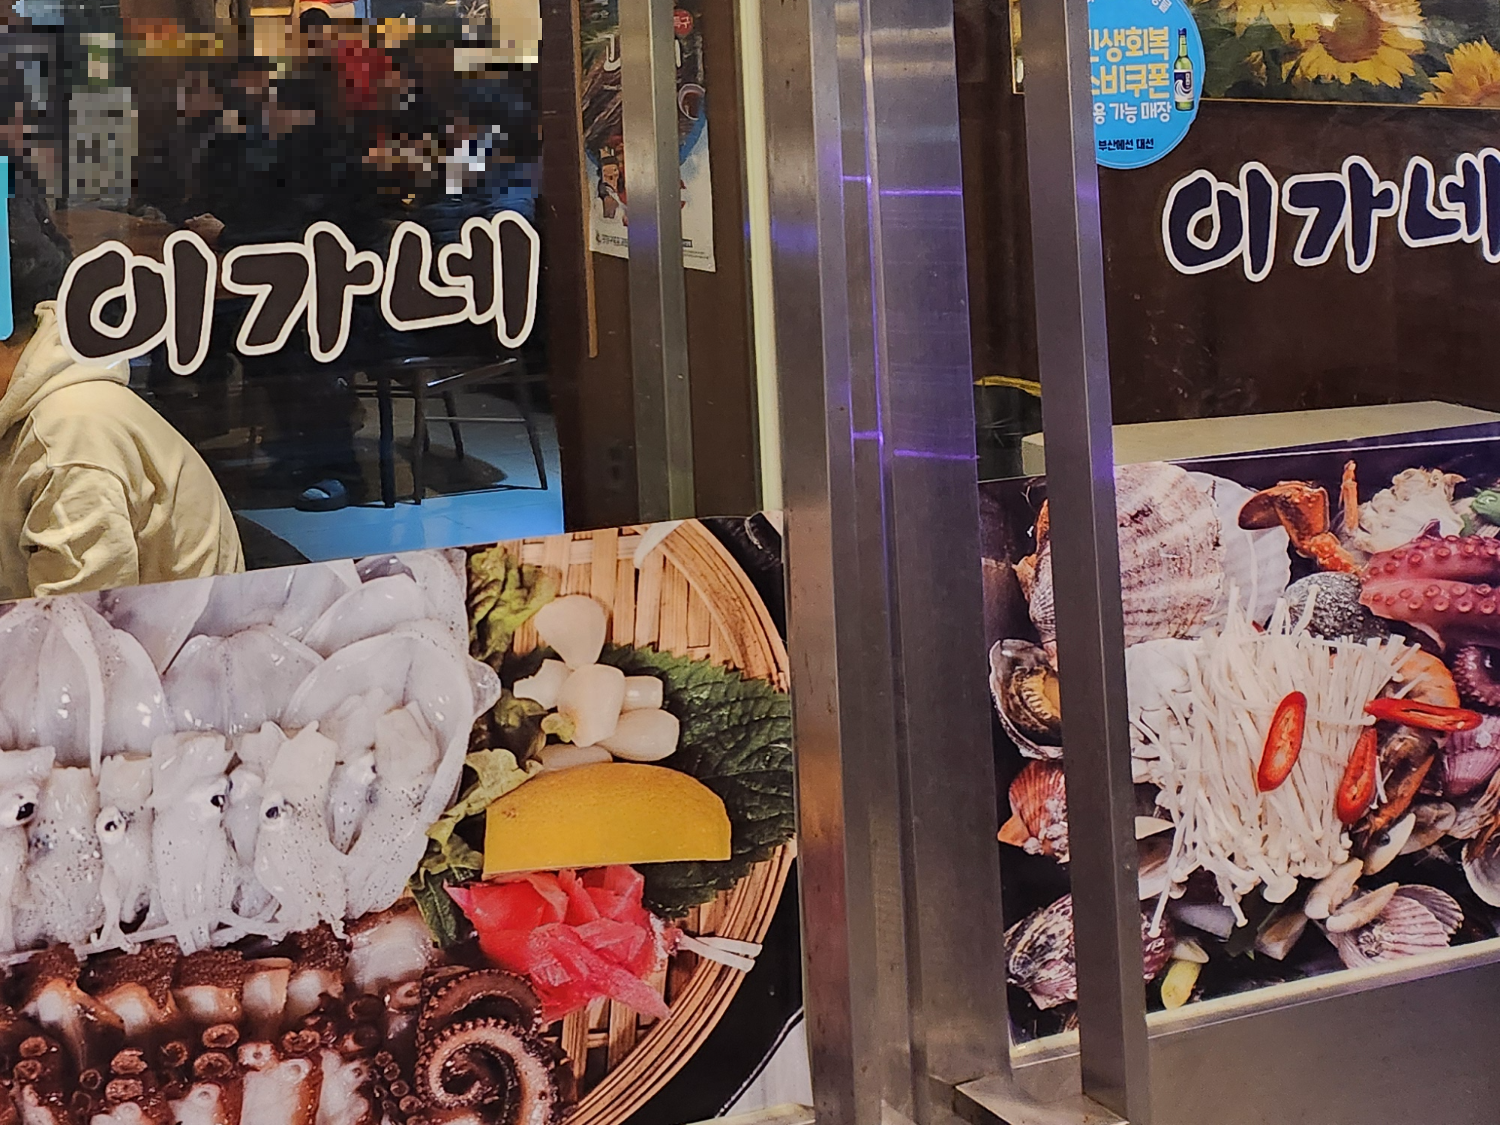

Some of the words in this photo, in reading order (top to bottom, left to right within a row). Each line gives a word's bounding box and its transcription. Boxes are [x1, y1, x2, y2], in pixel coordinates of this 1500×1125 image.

[1098, 138, 1134, 151] 부산에선
[1136, 138, 1154, 150] 대선
[1109, 102, 1138, 124] 가능
[1141, 100, 1172, 123] 매장
[1162, 148, 1500, 281] 이가네
[57, 210, 541, 376] 이가네
